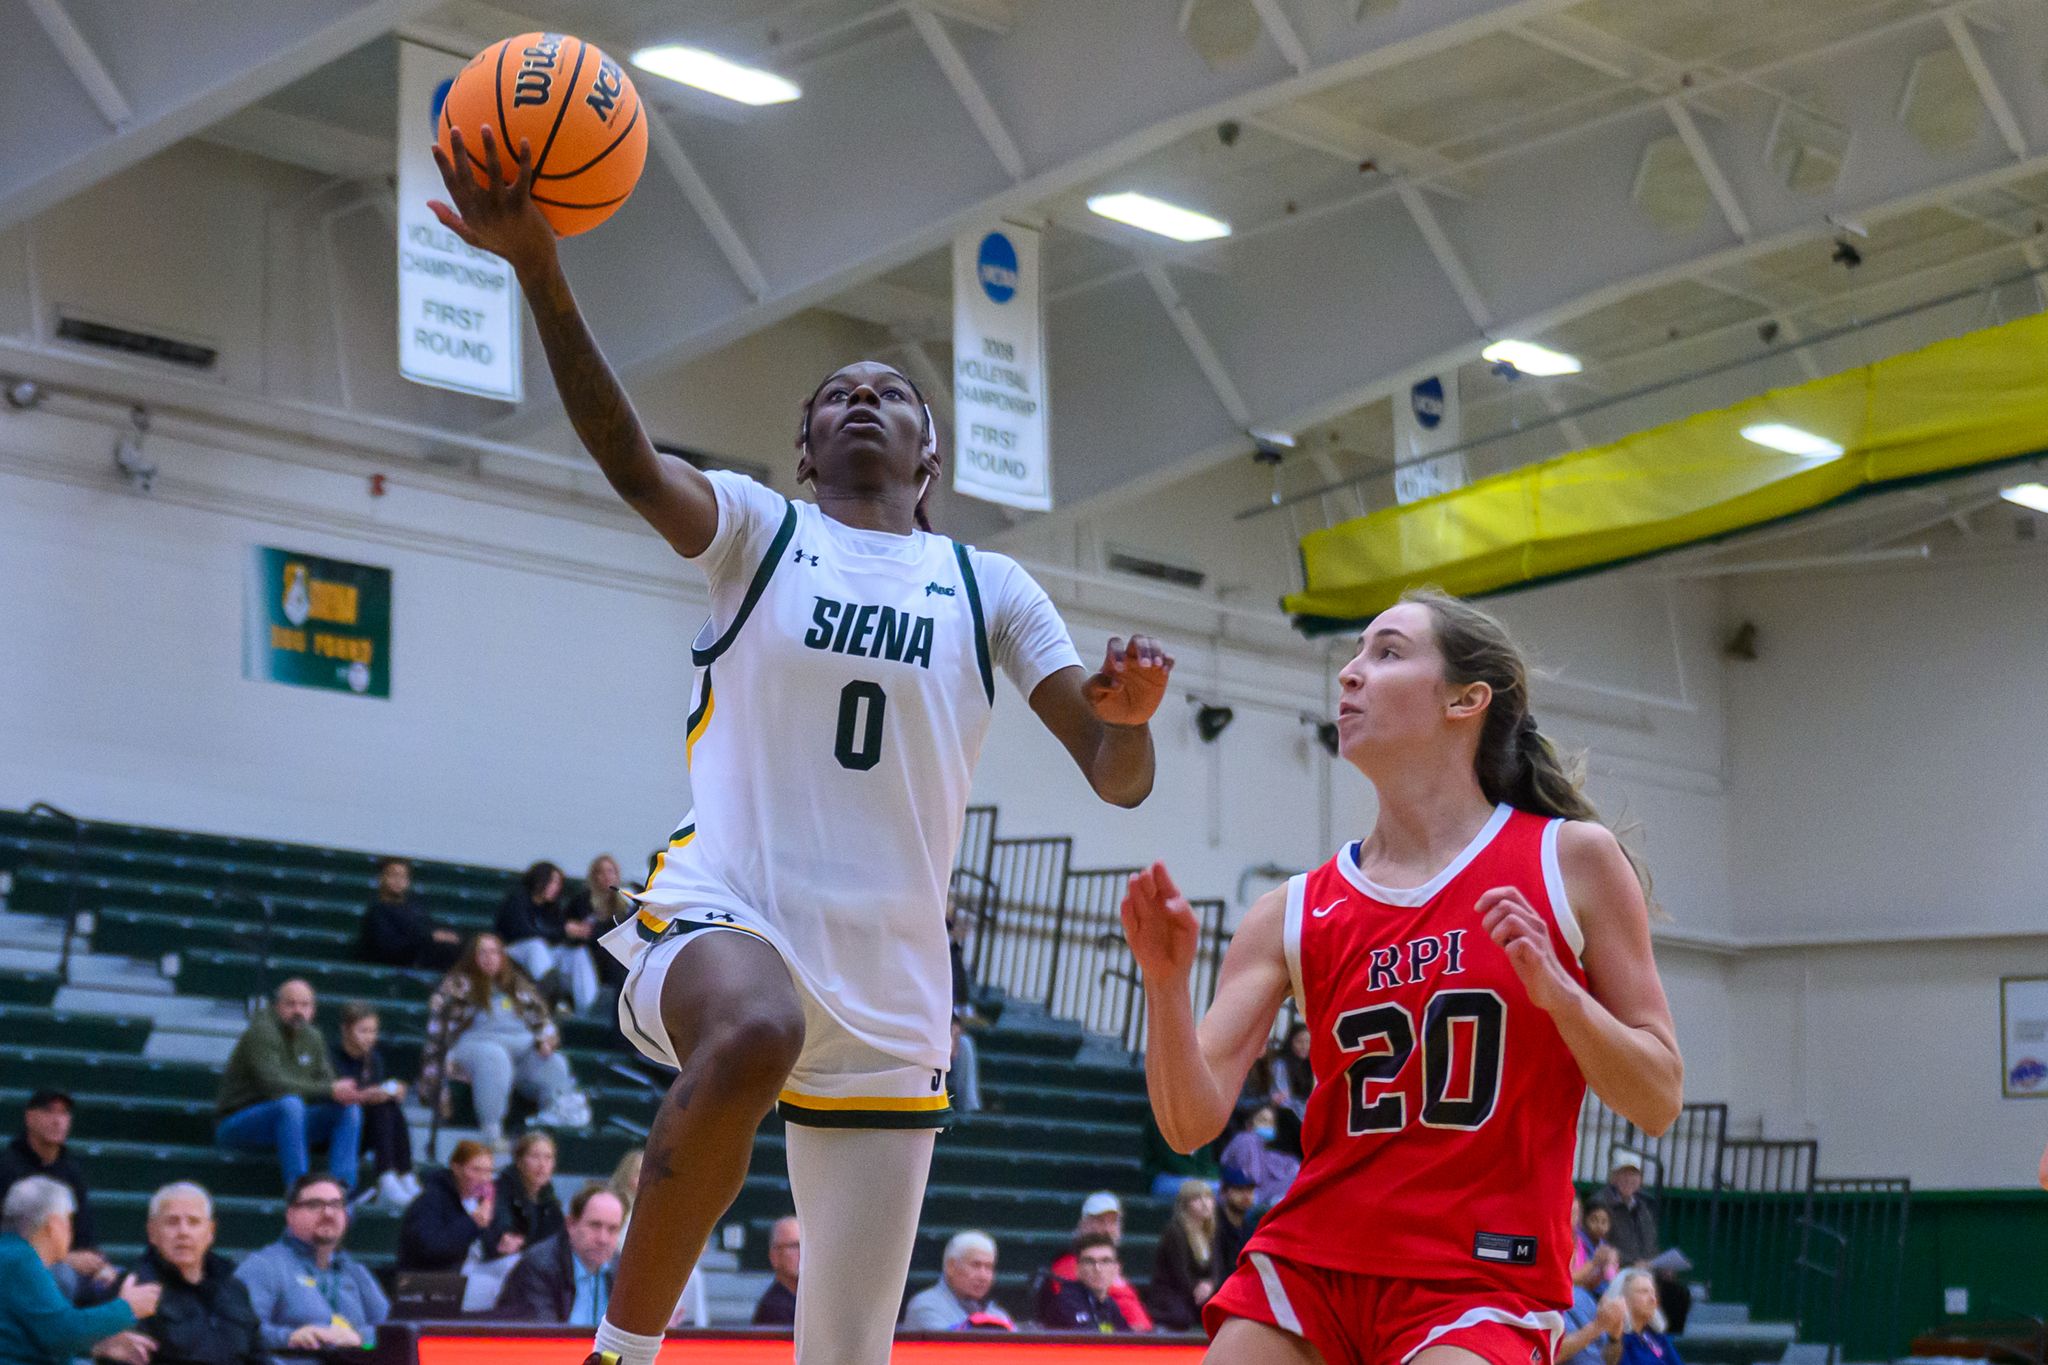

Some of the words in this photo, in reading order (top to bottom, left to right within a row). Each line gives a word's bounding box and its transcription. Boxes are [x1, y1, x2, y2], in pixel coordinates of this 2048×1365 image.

[422, 299, 486, 332] FIRST
[414, 327, 494, 365] ROUND
[971, 423, 1018, 450] FIRST
[965, 448, 1027, 480] ROUND
[804, 596, 934, 669] SIENA
[834, 680, 887, 771] 0
[1367, 930, 1468, 991] RPI
[1332, 988, 1507, 1137] 20
[1516, 1245, 1529, 1257] M
